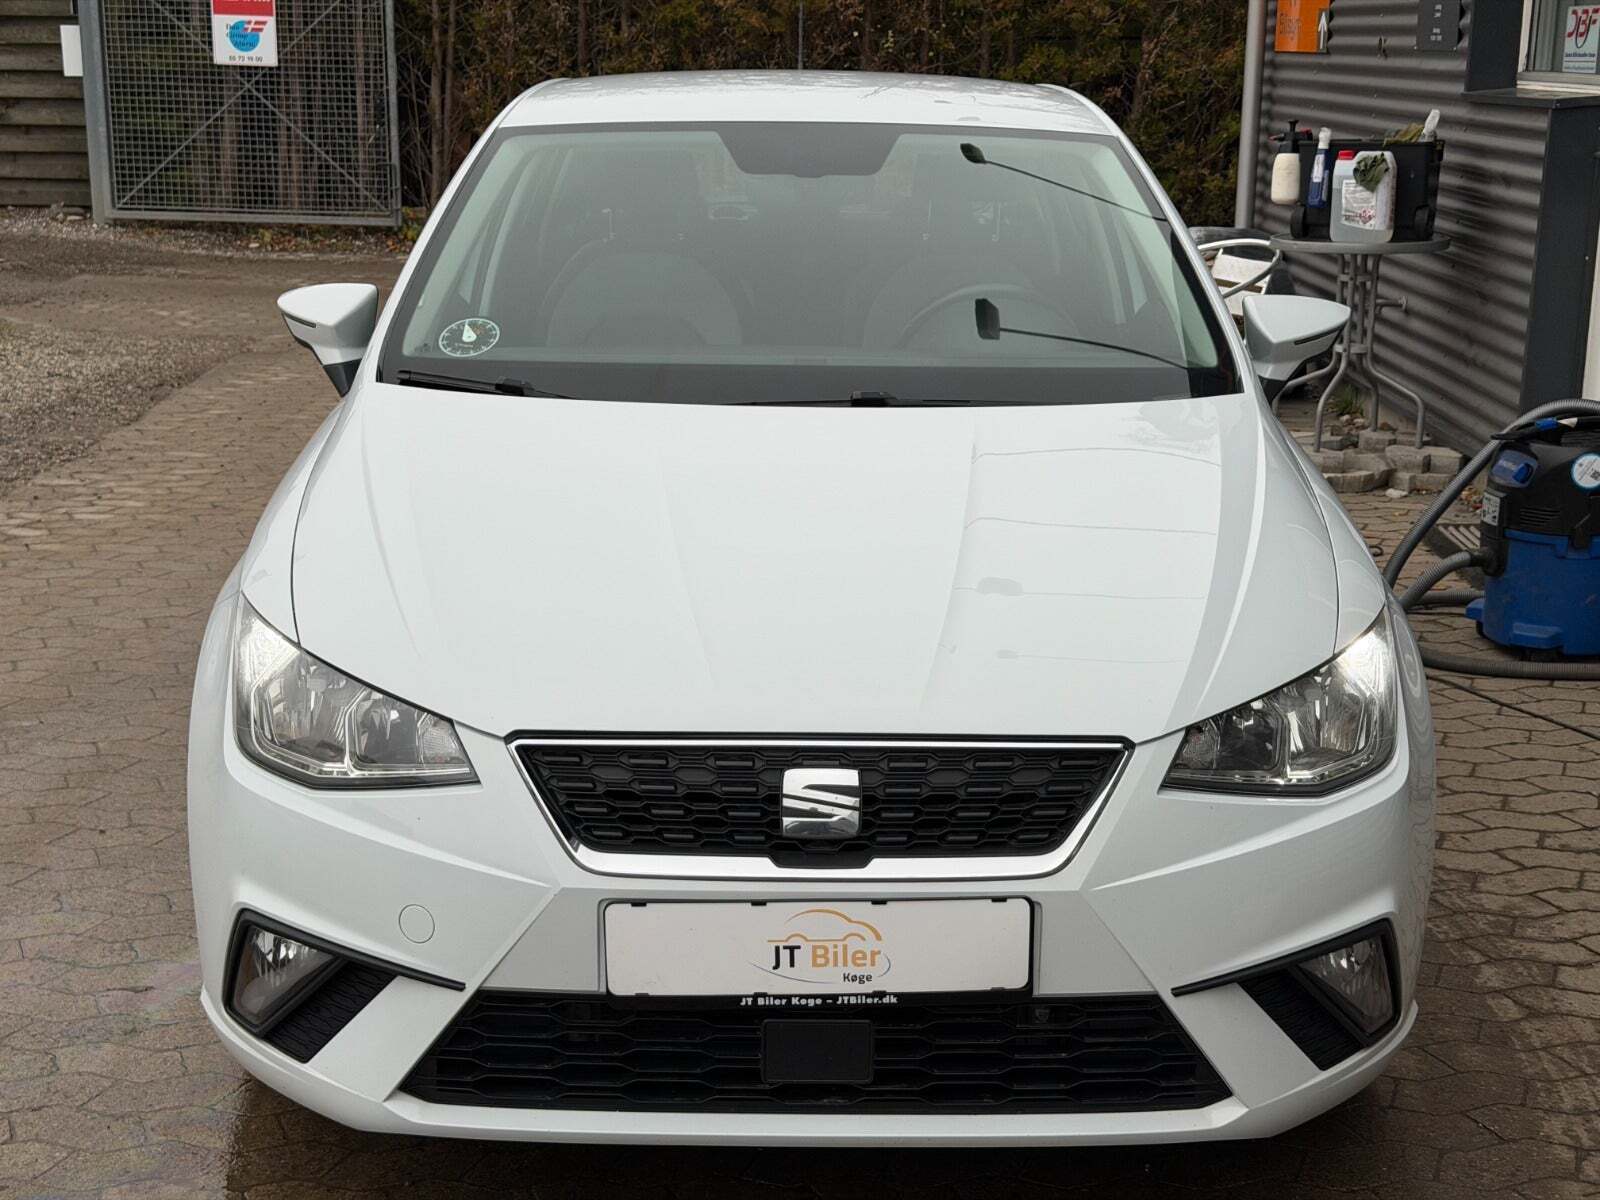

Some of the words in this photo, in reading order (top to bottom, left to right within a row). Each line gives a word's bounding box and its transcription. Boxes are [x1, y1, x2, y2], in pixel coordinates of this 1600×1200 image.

[772, 945, 801, 970] JT
[811, 944, 881, 968] Biler
[843, 973, 873, 985] Køge
[740, 997, 753, 1006] JT
[757, 997, 787, 1006] Biler
[836, 995, 898, 1005] JTBiler.dk
